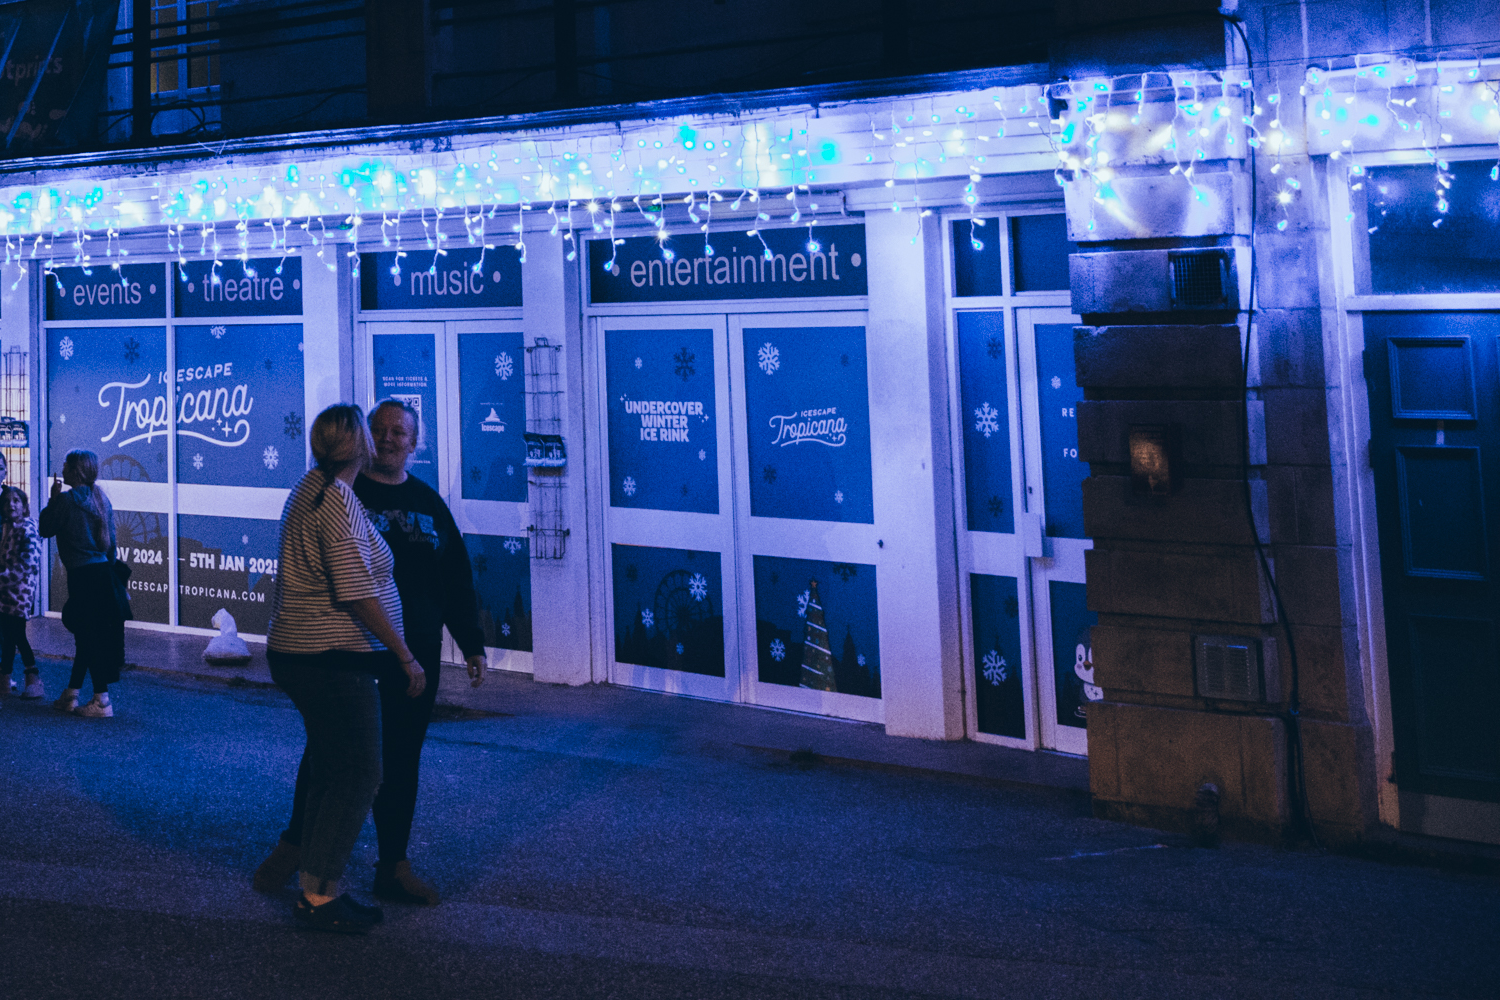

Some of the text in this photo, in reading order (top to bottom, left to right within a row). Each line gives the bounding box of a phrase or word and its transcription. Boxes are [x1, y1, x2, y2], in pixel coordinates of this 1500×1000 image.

[630, 243, 840, 288] entertainment
[73, 272, 284, 306] events theatre
[411, 261, 484, 296] music
[158, 362, 233, 385] ICESCAPE
[625, 400, 704, 416] UNDERCOVER
[800, 407, 836, 418] ICESCAPE
[640, 414, 688, 429] WINTER
[769, 411, 848, 447] Tropicana
[640, 428, 690, 443] ICE RINK
[133, 548, 163, 565] 2024
[189, 552, 216, 570] 5TH
[219, 554, 245, 572] JAN
[128, 580, 266, 603] ICESCAPTROPICANA.COM
